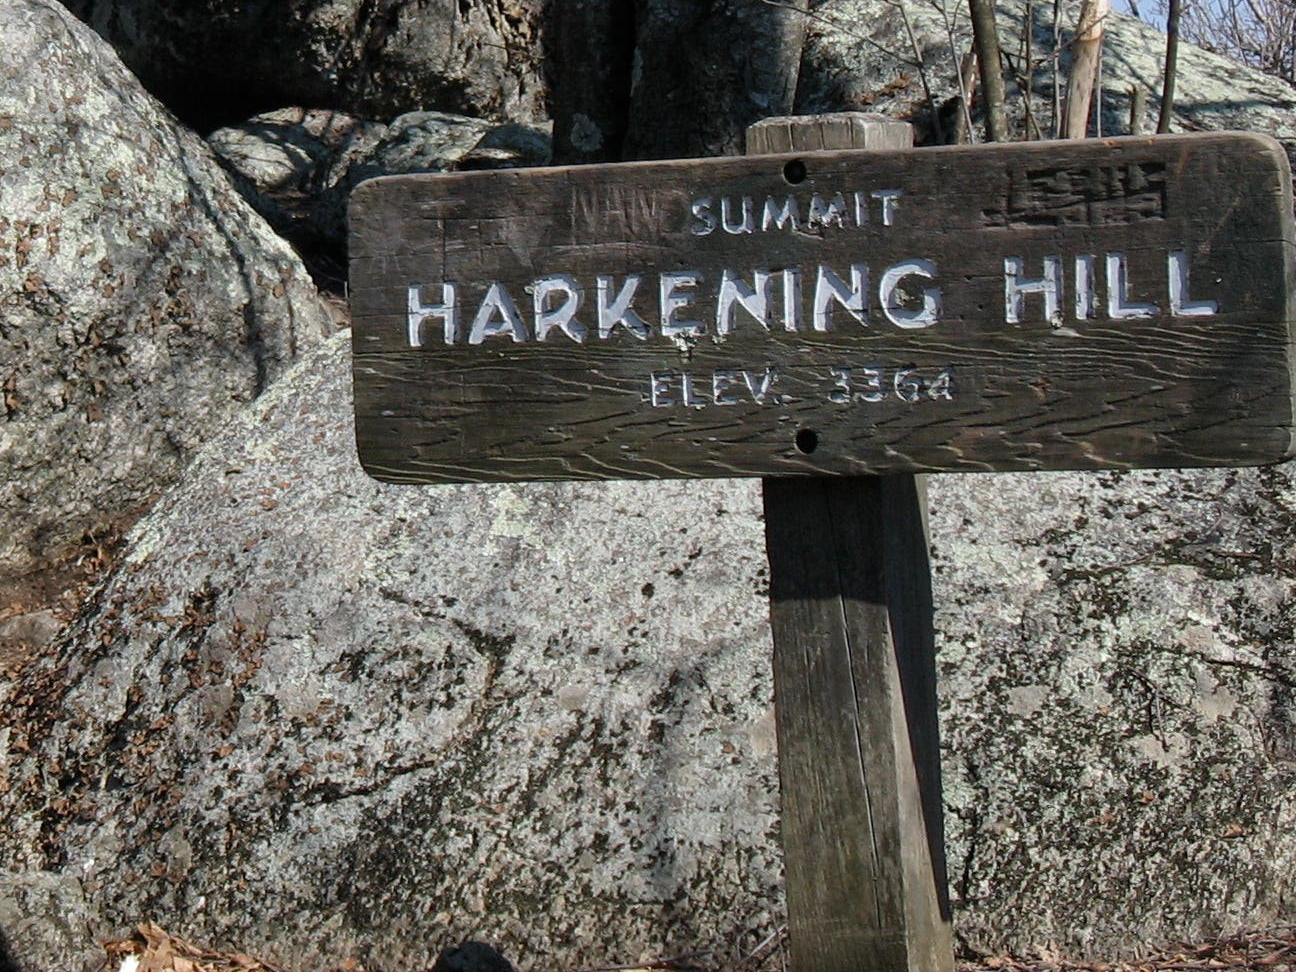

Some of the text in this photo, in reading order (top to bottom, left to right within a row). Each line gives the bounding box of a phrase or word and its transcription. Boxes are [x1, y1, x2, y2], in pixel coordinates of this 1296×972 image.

[691, 188, 902, 236] SUMMIT
[407, 250, 1220, 347] HARKENING HILL
[826, 362, 955, 404] 3364
